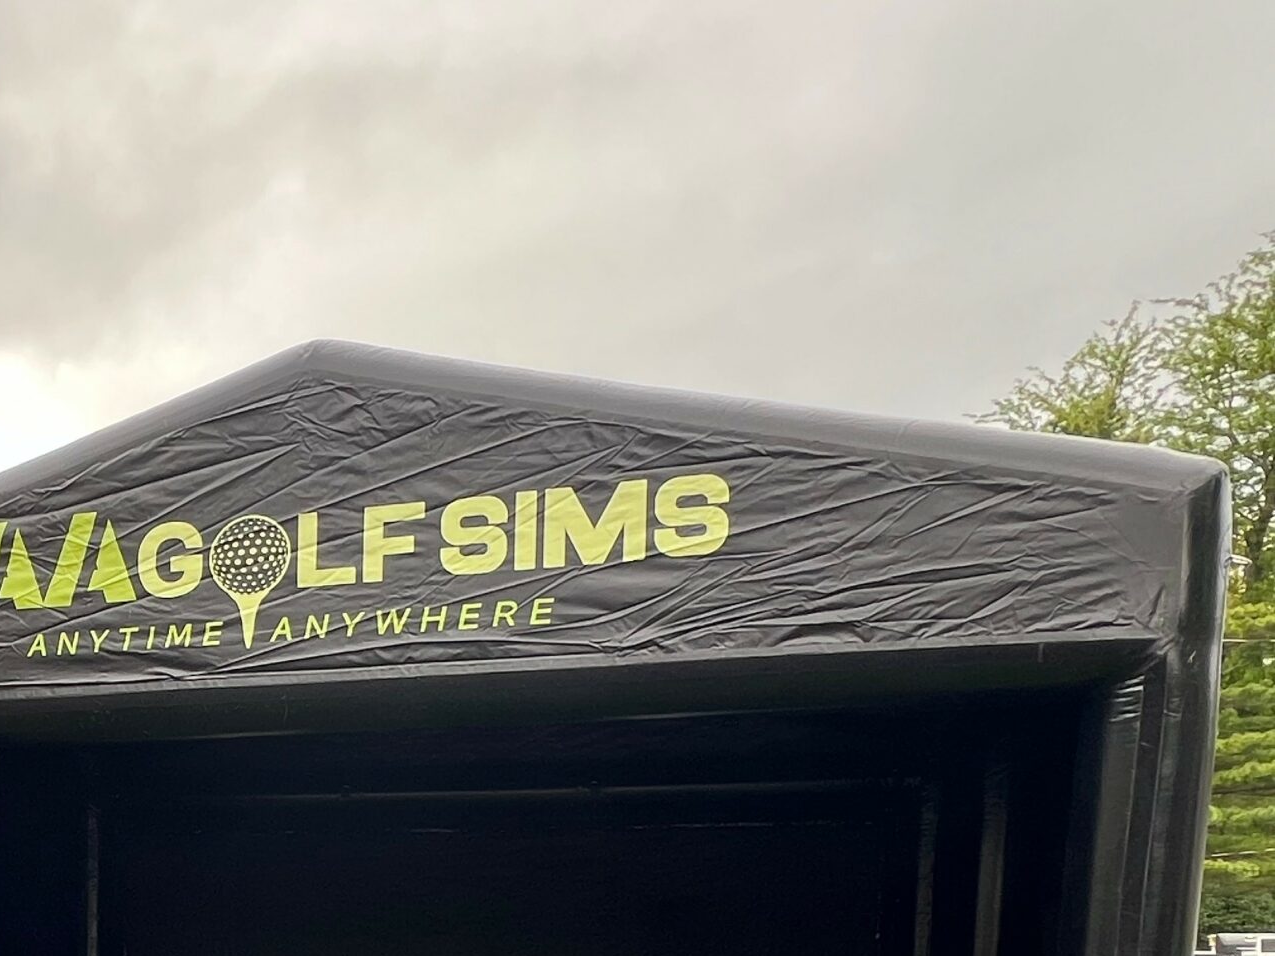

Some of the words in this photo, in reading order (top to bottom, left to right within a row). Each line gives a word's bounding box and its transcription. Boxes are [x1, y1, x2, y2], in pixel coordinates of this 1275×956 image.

[442, 471, 733, 574] SIMS
[27, 620, 225, 658] ANYTIME
[272, 597, 557, 642] ANYWHERE
